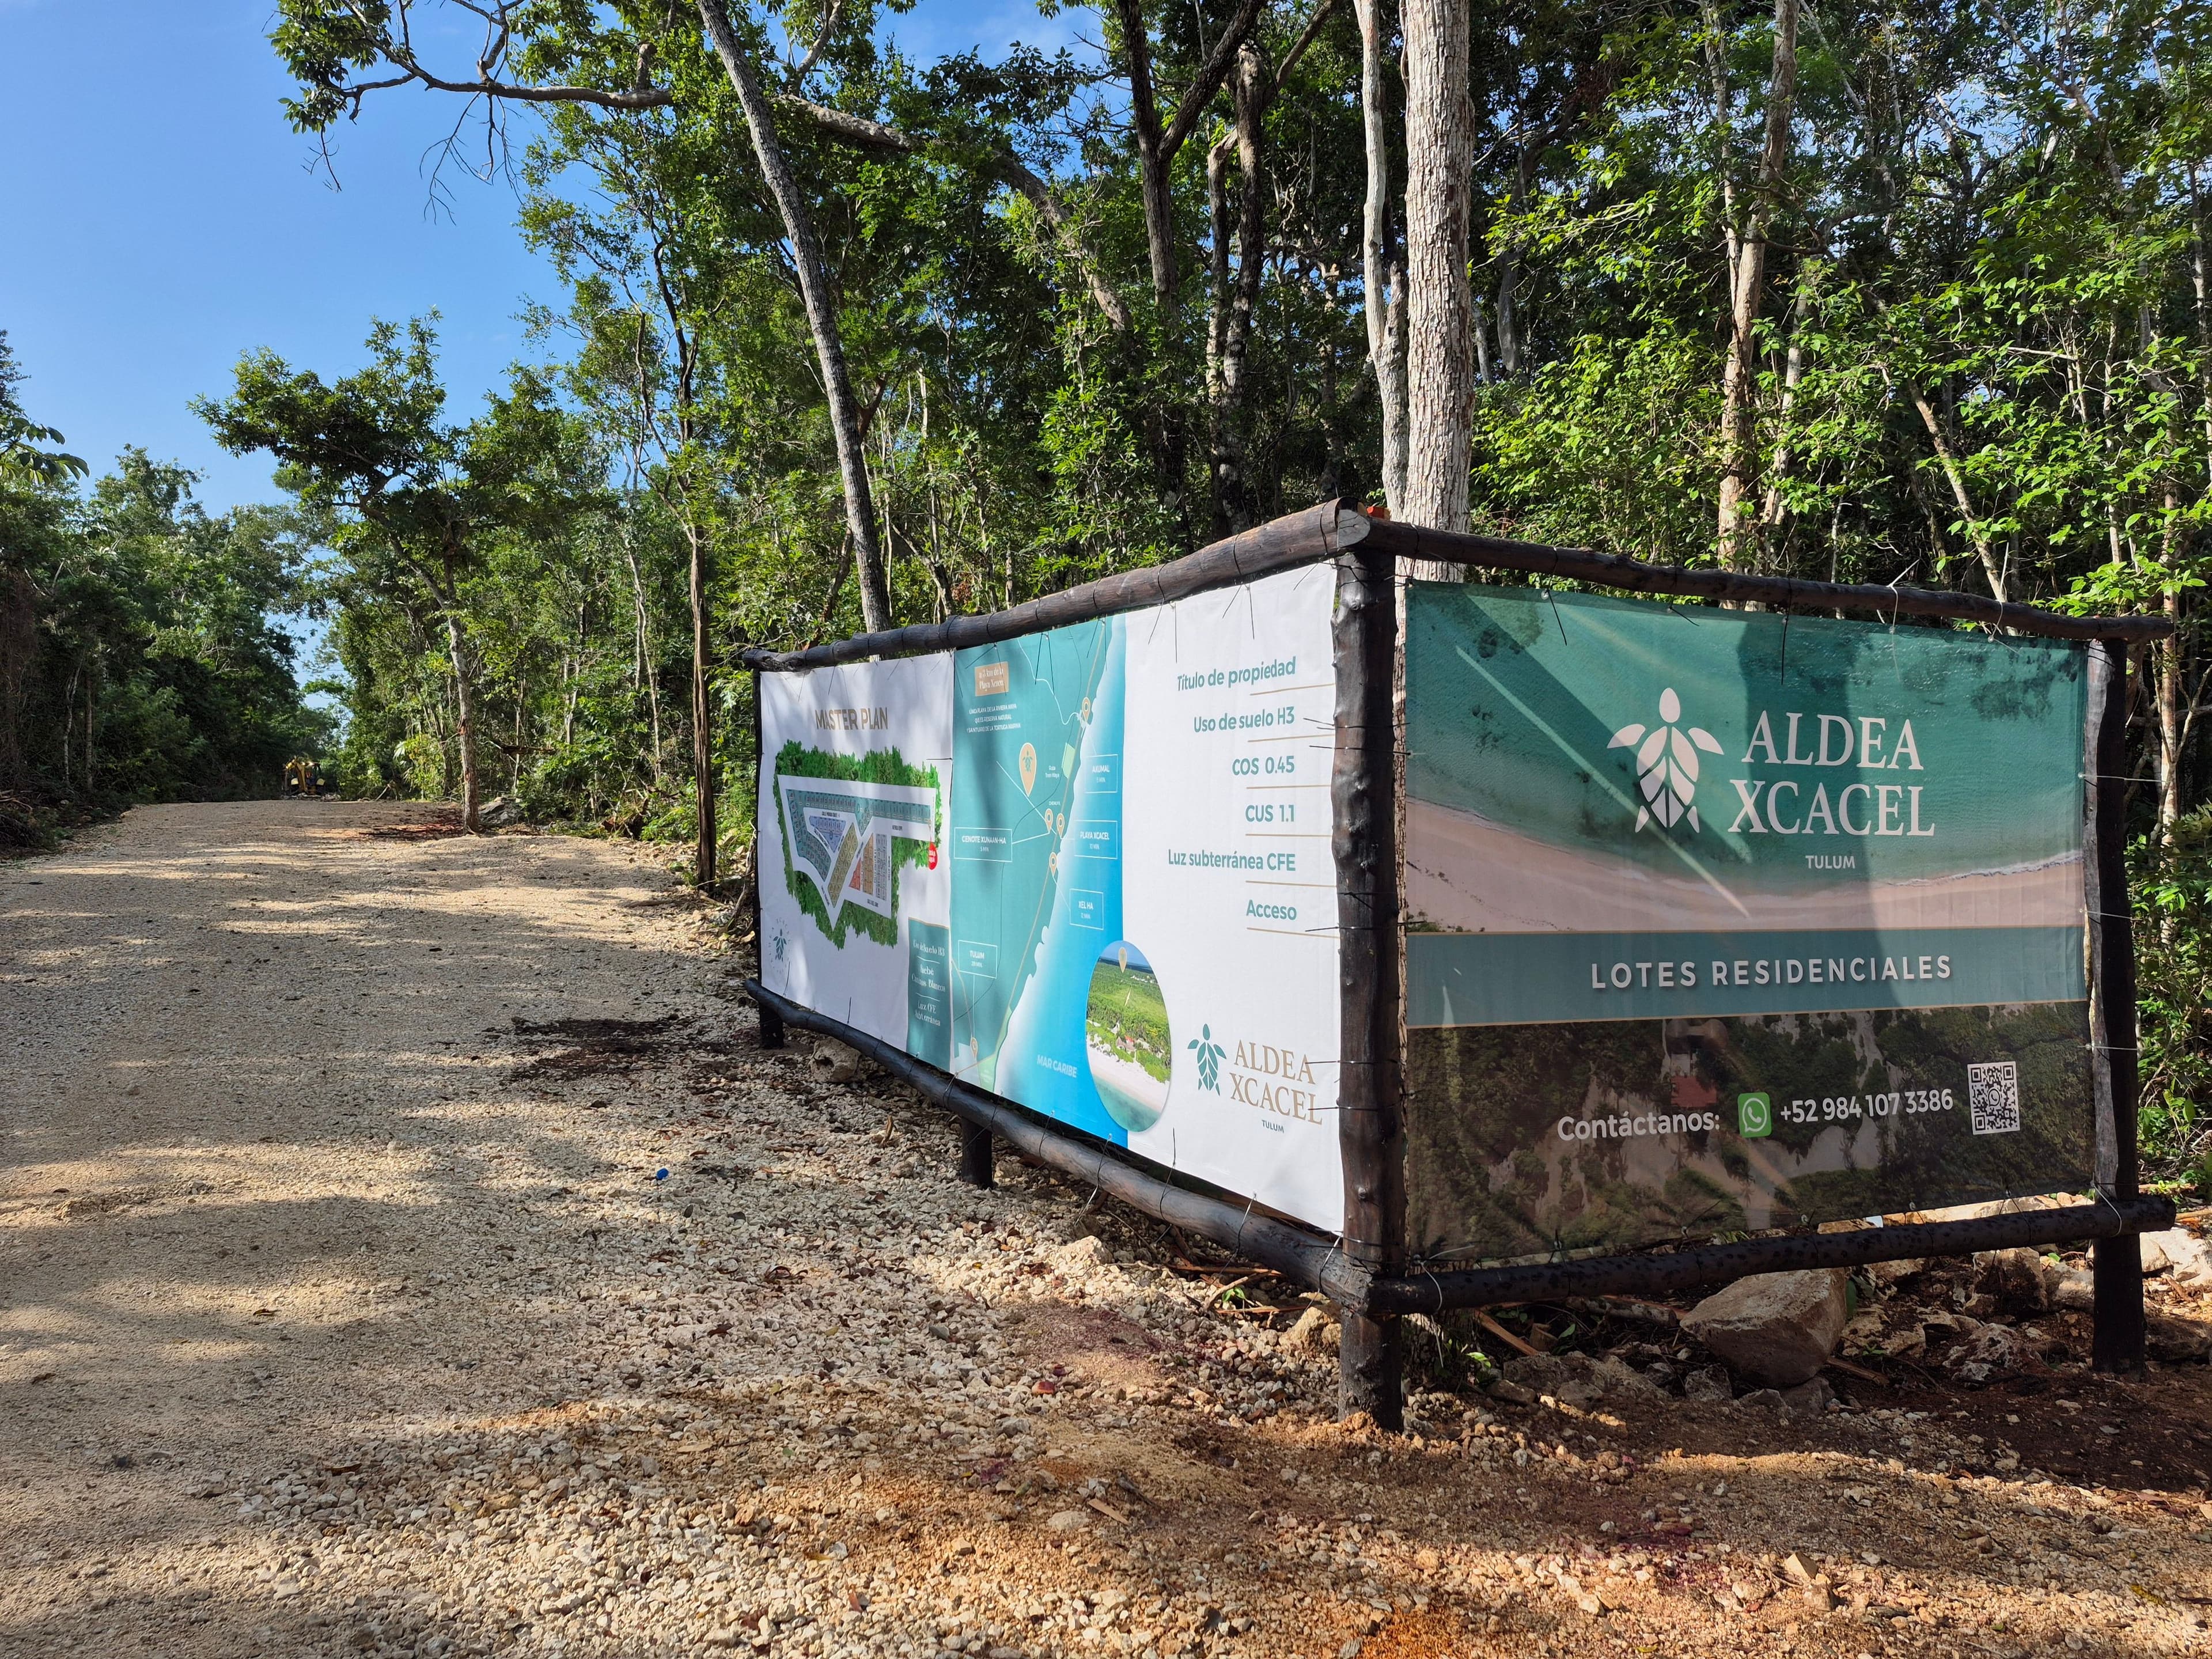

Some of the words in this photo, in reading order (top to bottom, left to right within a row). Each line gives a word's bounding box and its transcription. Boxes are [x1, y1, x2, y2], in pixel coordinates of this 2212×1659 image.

[1177, 671, 1205, 691] Título
[1208, 669, 1225, 687] de
[1228, 656, 1296, 687] propiedad
[815, 709, 858, 730] MASTER
[862, 707, 888, 730] PLAN
[1194, 716, 1215, 733] Uso
[1218, 713, 1237, 730] de
[1238, 709, 1274, 729] suelo
[1278, 706, 1295, 725] H3
[1741, 710, 1923, 770] ALDEA
[1232, 757, 1259, 775] COS
[1265, 755, 1295, 774] 0.45
[1245, 805, 1273, 822] CUS
[1279, 805, 1295, 822] 1.1
[1728, 779, 1935, 836] XCACEL
[1168, 849, 1186, 865] Luz
[1189, 850, 1263, 870] subterránea
[1267, 853, 1296, 871] CFE
[1805, 855, 1855, 869] TULUM
[1078, 901, 1086, 909] XEL
[1246, 900, 1297, 921] Acceso
[969, 950, 984, 959] TULUM
[1592, 961, 1696, 989] LOTES
[1712, 955, 1952, 986] RESIDENCIALES
[1037, 1055, 1052, 1073] MAR
[1053, 1059, 1077, 1078] CARIBE
[1234, 1039, 1316, 1085] ALDEA
[1229, 1072, 1323, 1125] XCACEL
[1262, 1119, 1285, 1134] TULUM
[1557, 1111, 1720, 1142] Contáctanos:
[1780, 1101, 1816, 1124] +52
[1824, 1097, 1862, 1122] 984
[1868, 1093, 1900, 1118] 107
[1905, 1088, 1954, 1113] 3386
